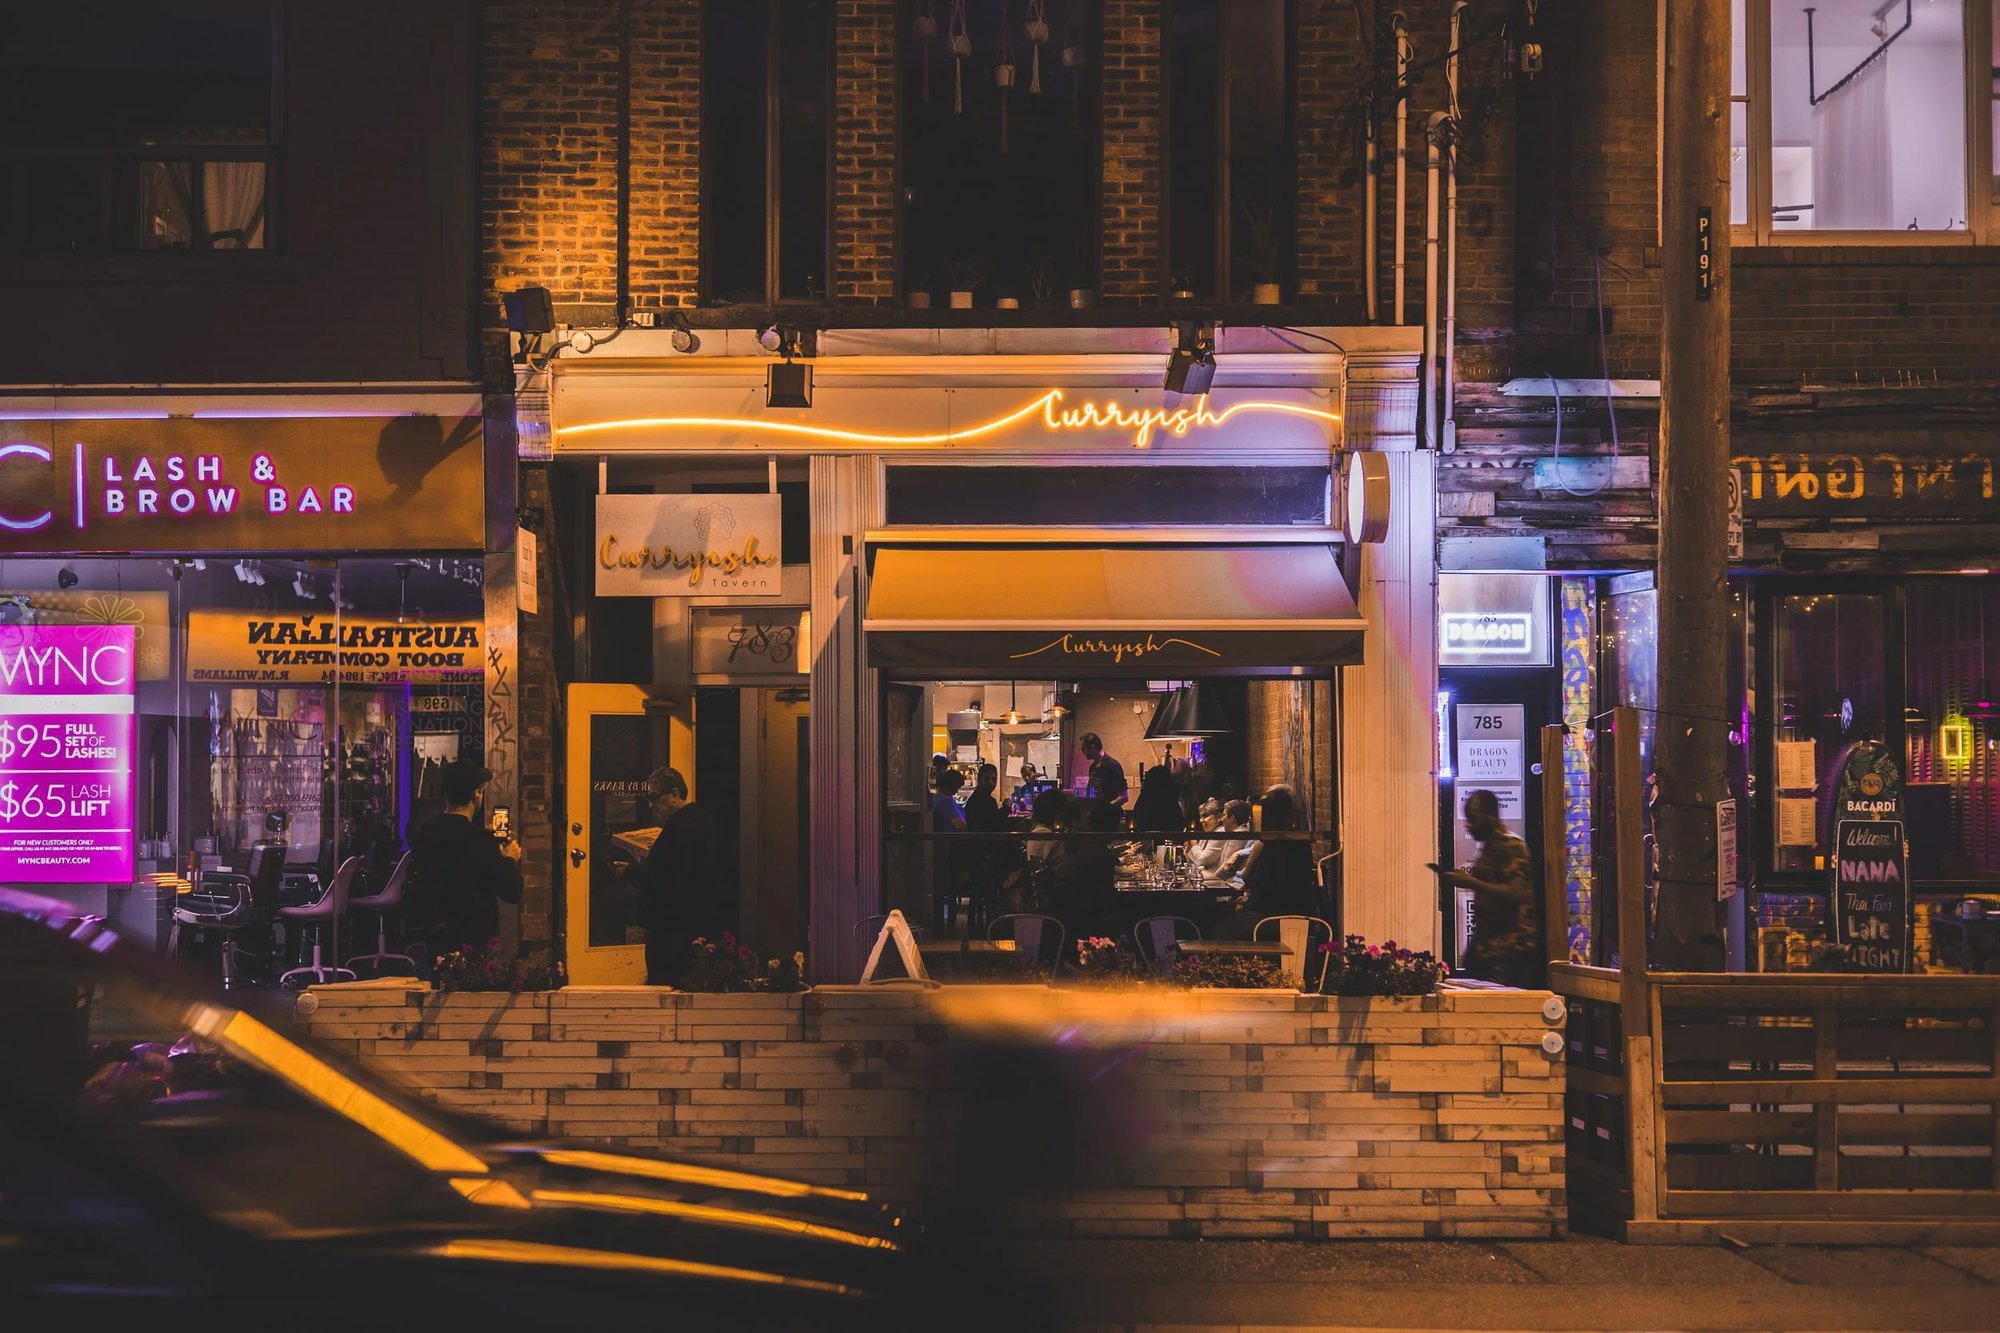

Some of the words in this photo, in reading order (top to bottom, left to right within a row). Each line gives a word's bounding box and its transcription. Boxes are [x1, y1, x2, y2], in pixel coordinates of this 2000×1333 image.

[1699, 217, 1709, 288] P191
[1043, 389, 1222, 448] Curryish
[106, 457, 222, 481] LASH
[253, 456, 275, 481] &
[106, 488, 235, 513] BROW
[269, 487, 352, 513] BAR
[600, 534, 777, 588] Curryish
[711, 577, 768, 588] Tavern
[727, 615, 797, 664] 783
[1447, 622, 1525, 641] DRAGON
[1061, 633, 1164, 664] Curryish
[0, 645, 127, 687] MYNC
[65, 723, 97, 735] FULL
[1473, 715, 1503, 730] 785
[0, 720, 62, 763] $95
[65, 736, 87, 747] SET
[88, 736, 106, 747] OF
[65, 747, 117, 759] LASHES!
[1469, 746, 1509, 757] DRAGON
[1470, 758, 1509, 768] BEAUTY
[0, 779, 66, 823] $65
[71, 784, 111, 799] LASH
[71, 800, 111, 817] LIFT
[1846, 798, 1897, 812] BACARDÍ
[13, 839, 26, 847] FOR
[26, 839, 41, 847] NEW
[42, 839, 78, 847] CUSTOMERS
[78, 839, 95, 847] ONLY
[1841, 859, 1900, 882] NANA
